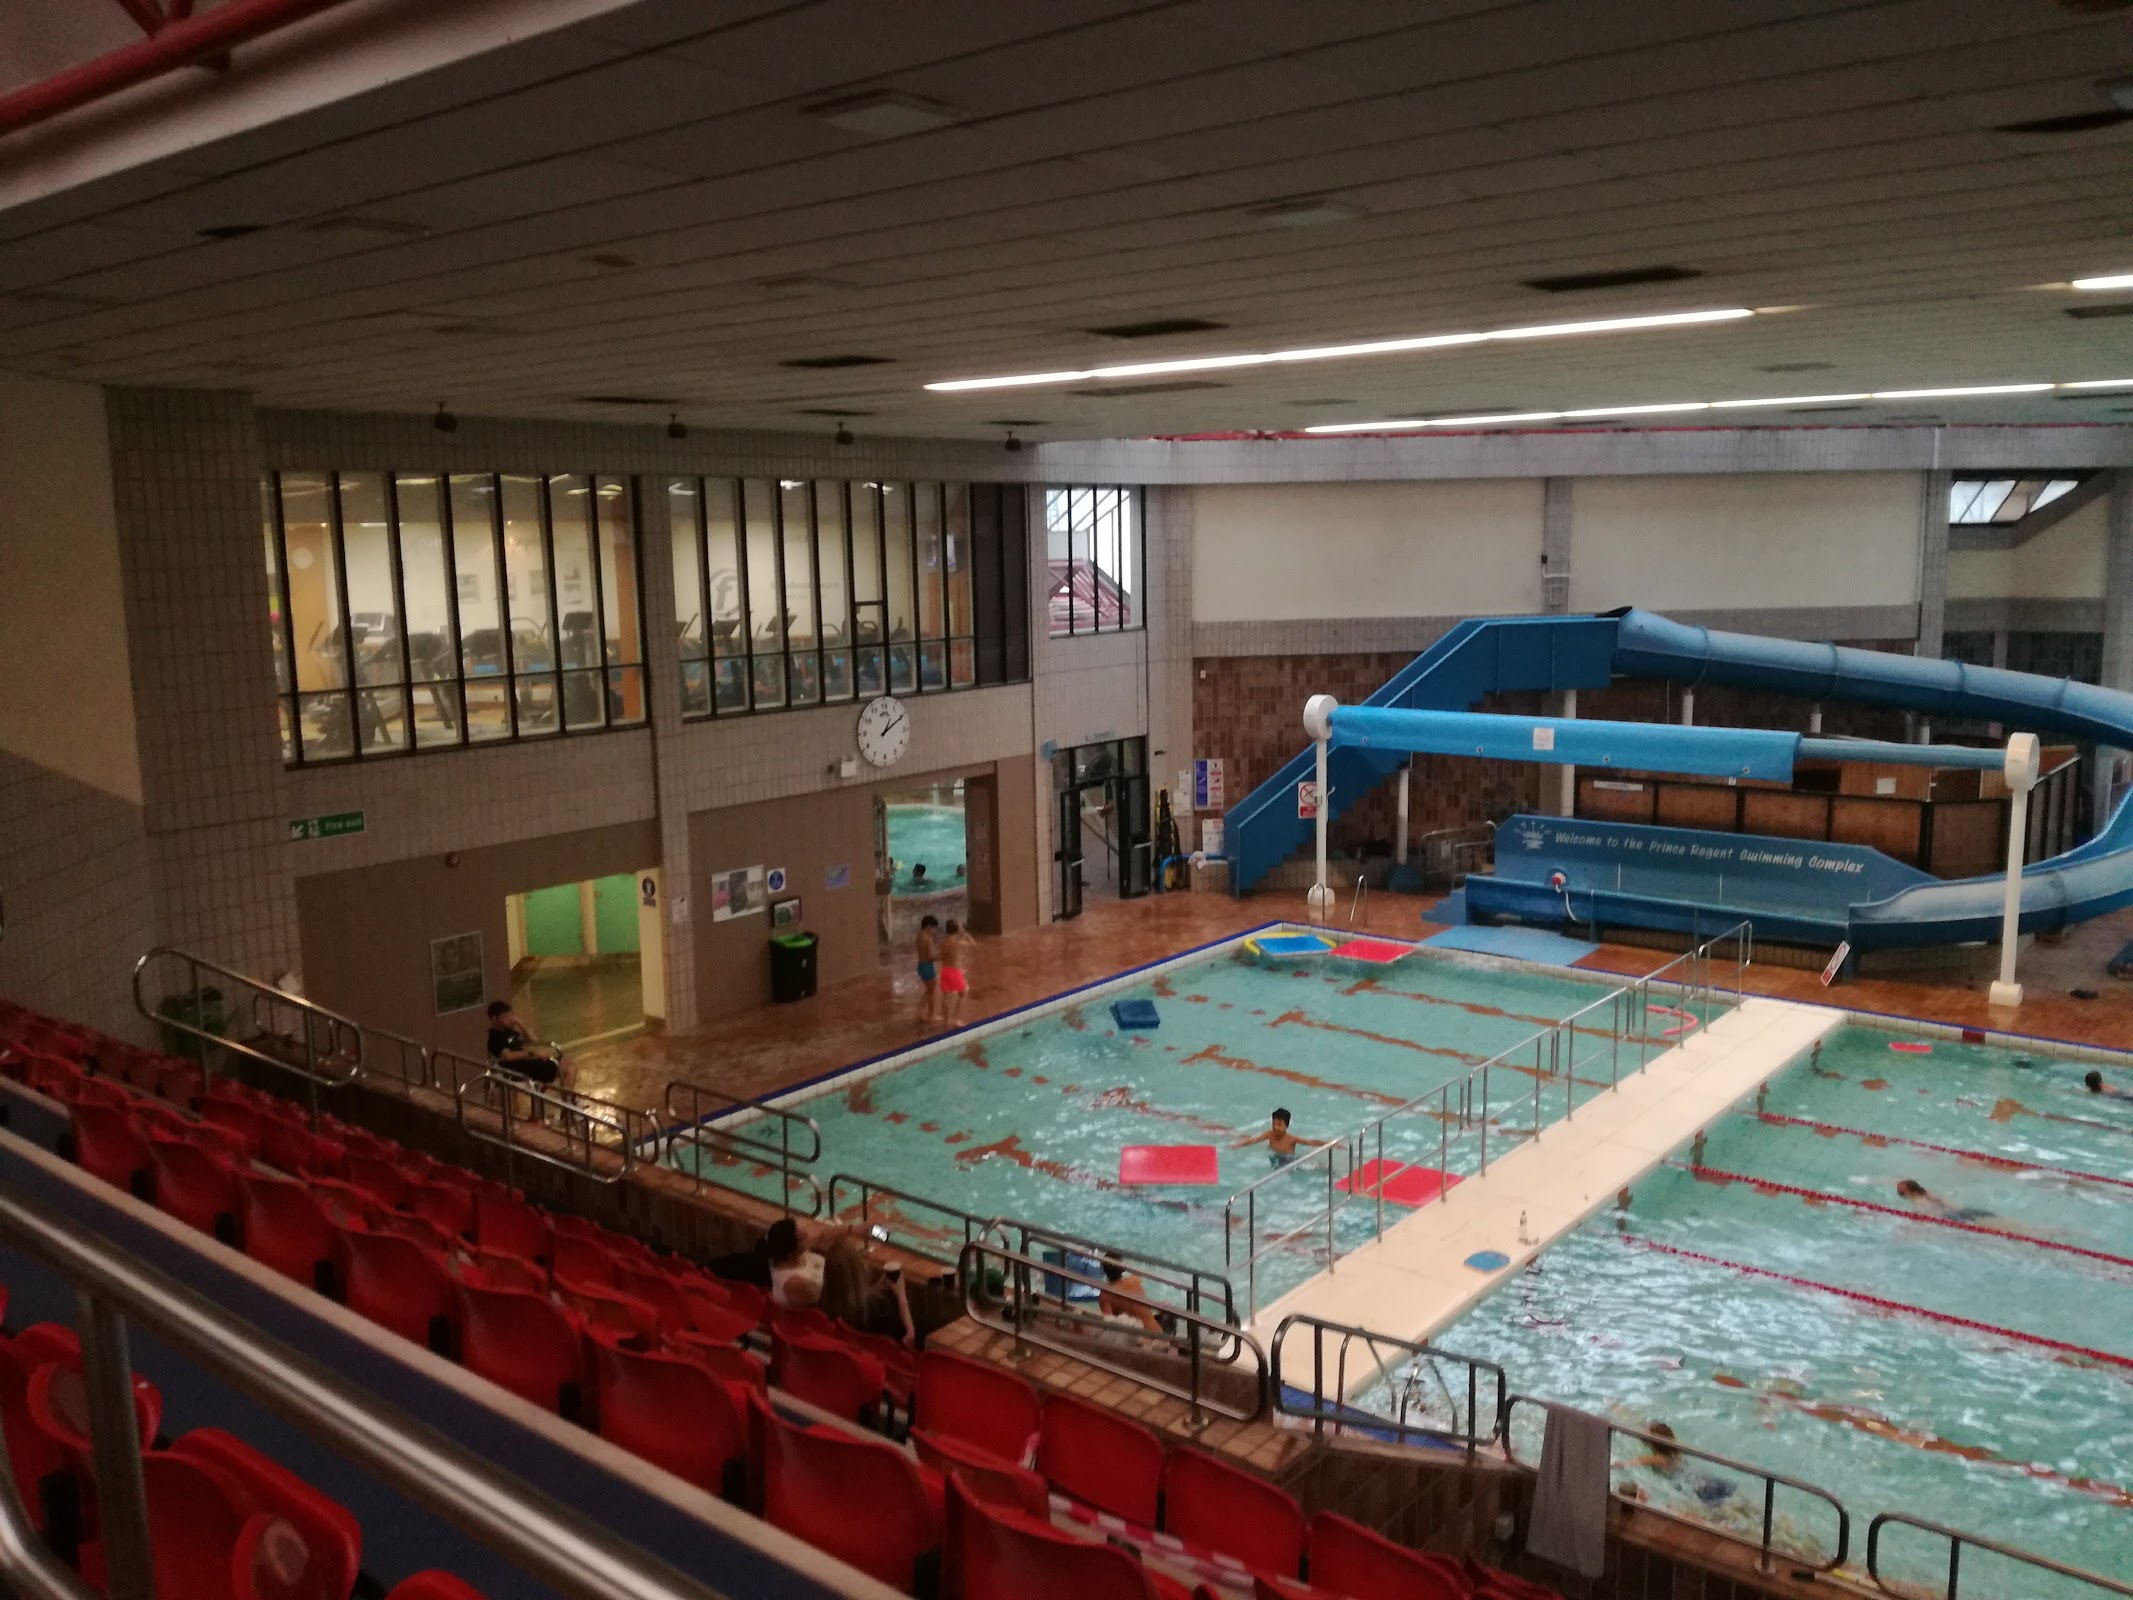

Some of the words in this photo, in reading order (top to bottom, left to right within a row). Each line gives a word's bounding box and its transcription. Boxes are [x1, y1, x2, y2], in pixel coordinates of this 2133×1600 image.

[1555, 831, 1601, 847] Welcome
[1607, 835, 1619, 848] to
[1623, 836, 1644, 850] the
[1648, 840, 1686, 856] Prince
[1689, 844, 1734, 860] Regent
[1739, 848, 1804, 869] Swimming
[1807, 855, 1865, 874] Complex
